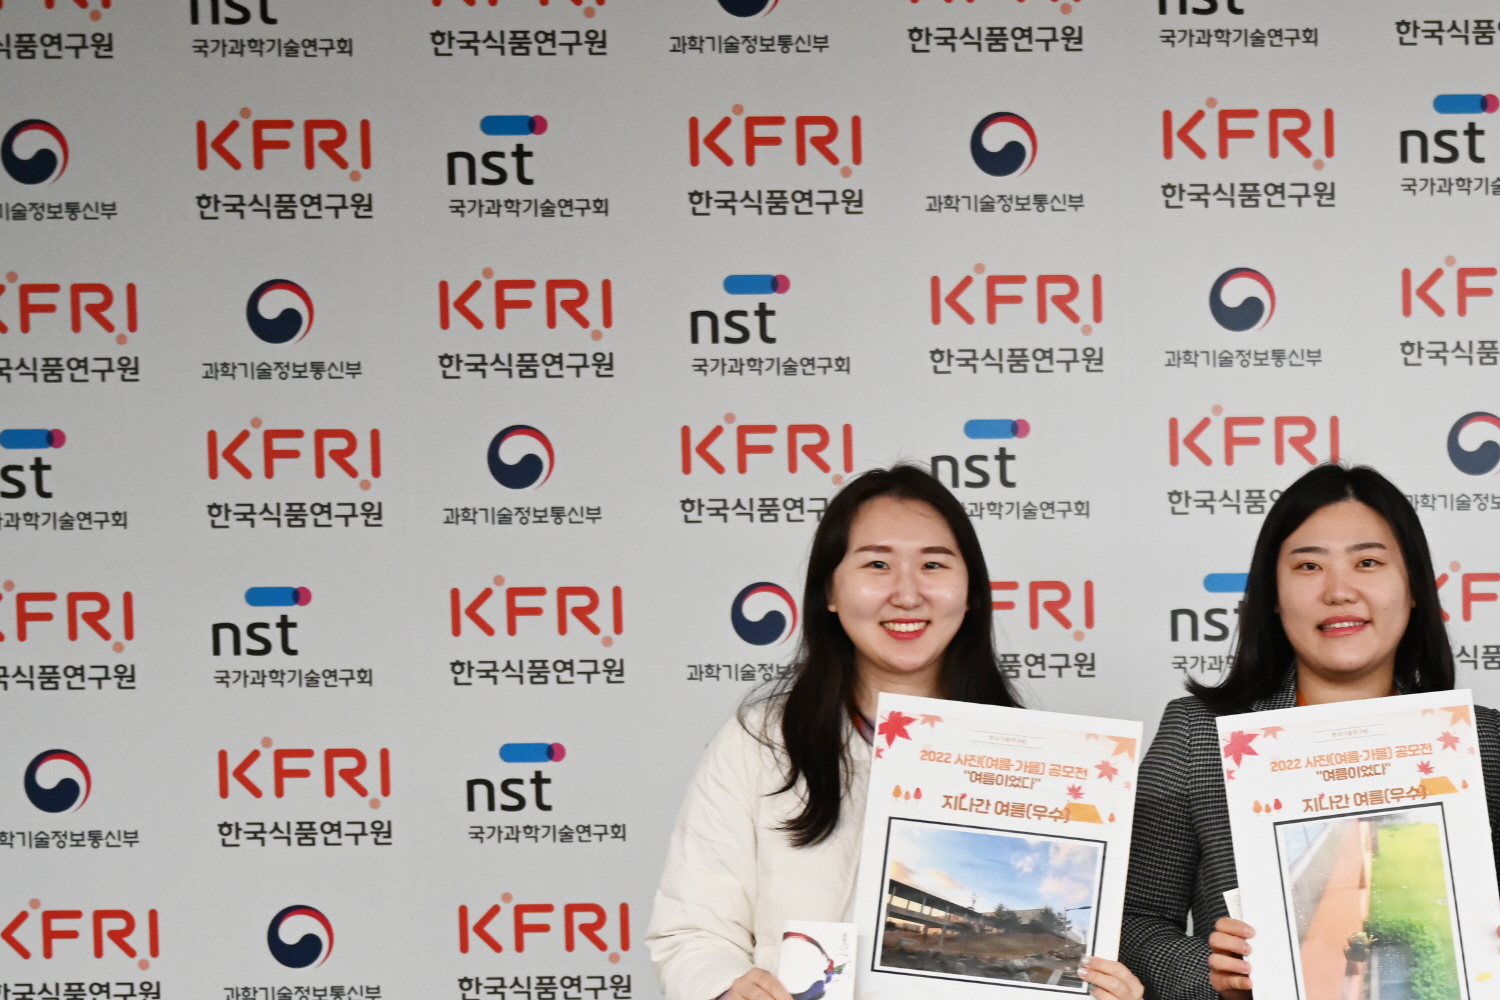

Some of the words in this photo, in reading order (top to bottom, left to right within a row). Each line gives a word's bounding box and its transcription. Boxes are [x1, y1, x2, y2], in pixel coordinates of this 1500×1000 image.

[192, 38, 352, 57] 국가과학기술연구회
[430, 30, 607, 56] 한국식품연구원
[670, 35, 829, 54] 과학기술정보통신부
[908, 26, 1083, 53] 한국식품연구원
[1159, 28, 1318, 47] 국가과학기술연구회
[197, 120, 370, 170] KFRI
[690, 116, 861, 166] KFRI
[1164, 109, 1334, 159] KFRI
[1400, 122, 1485, 164] nst
[447, 144, 533, 185] nst
[196, 193, 372, 220] 한국식품연구원
[449, 198, 608, 218] 국가과학기술연구회
[688, 189, 863, 216] 한국식품연구원
[926, 194, 1084, 213] 과학기술정보통신부
[1161, 182, 1335, 209] 한국식품연구원
[440, 279, 612, 329] KFRI
[932, 275, 1102, 324] KFRI
[690, 302, 776, 344] nst
[202, 361, 362, 380] 과학기술정보통신부
[438, 352, 613, 379] 한국식품연구원
[692, 356, 850, 376] 국가과학기술연구회
[929, 347, 1103, 374] 한국식품연구원
[1165, 349, 1322, 368] 과학기술정보통신부
[208, 429, 380, 479] KFRI
[682, 424, 852, 474] KFRI
[1170, 416, 1339, 466] KFRI
[207, 502, 382, 528] 한국식품연구원
[443, 506, 602, 525] 과학기술정보통신부
[451, 586, 622, 636] KFRI
[212, 615, 298, 656] nst
[214, 668, 372, 688] 국가과학기술연구회
[450, 659, 624, 686] 한국식품연구원
[920, 750, 952, 764] 2022
[1048, 764, 1088, 780] 공모전
[1270, 758, 1302, 772] 2022
[1395, 743, 1434, 758] 공모전
[219, 748, 390, 798] KFRI
[467, 771, 552, 812] nst
[1302, 794, 1351, 813] 지나간
[1353, 785, 1427, 807] 여름(우수)
[941, 795, 991, 814] 지나간
[994, 801, 1070, 823] 여름(우수)
[218, 820, 392, 847] 한국식품연구원
[469, 824, 626, 843] 국가과학기술연구회
[460, 903, 629, 953] KFRI
